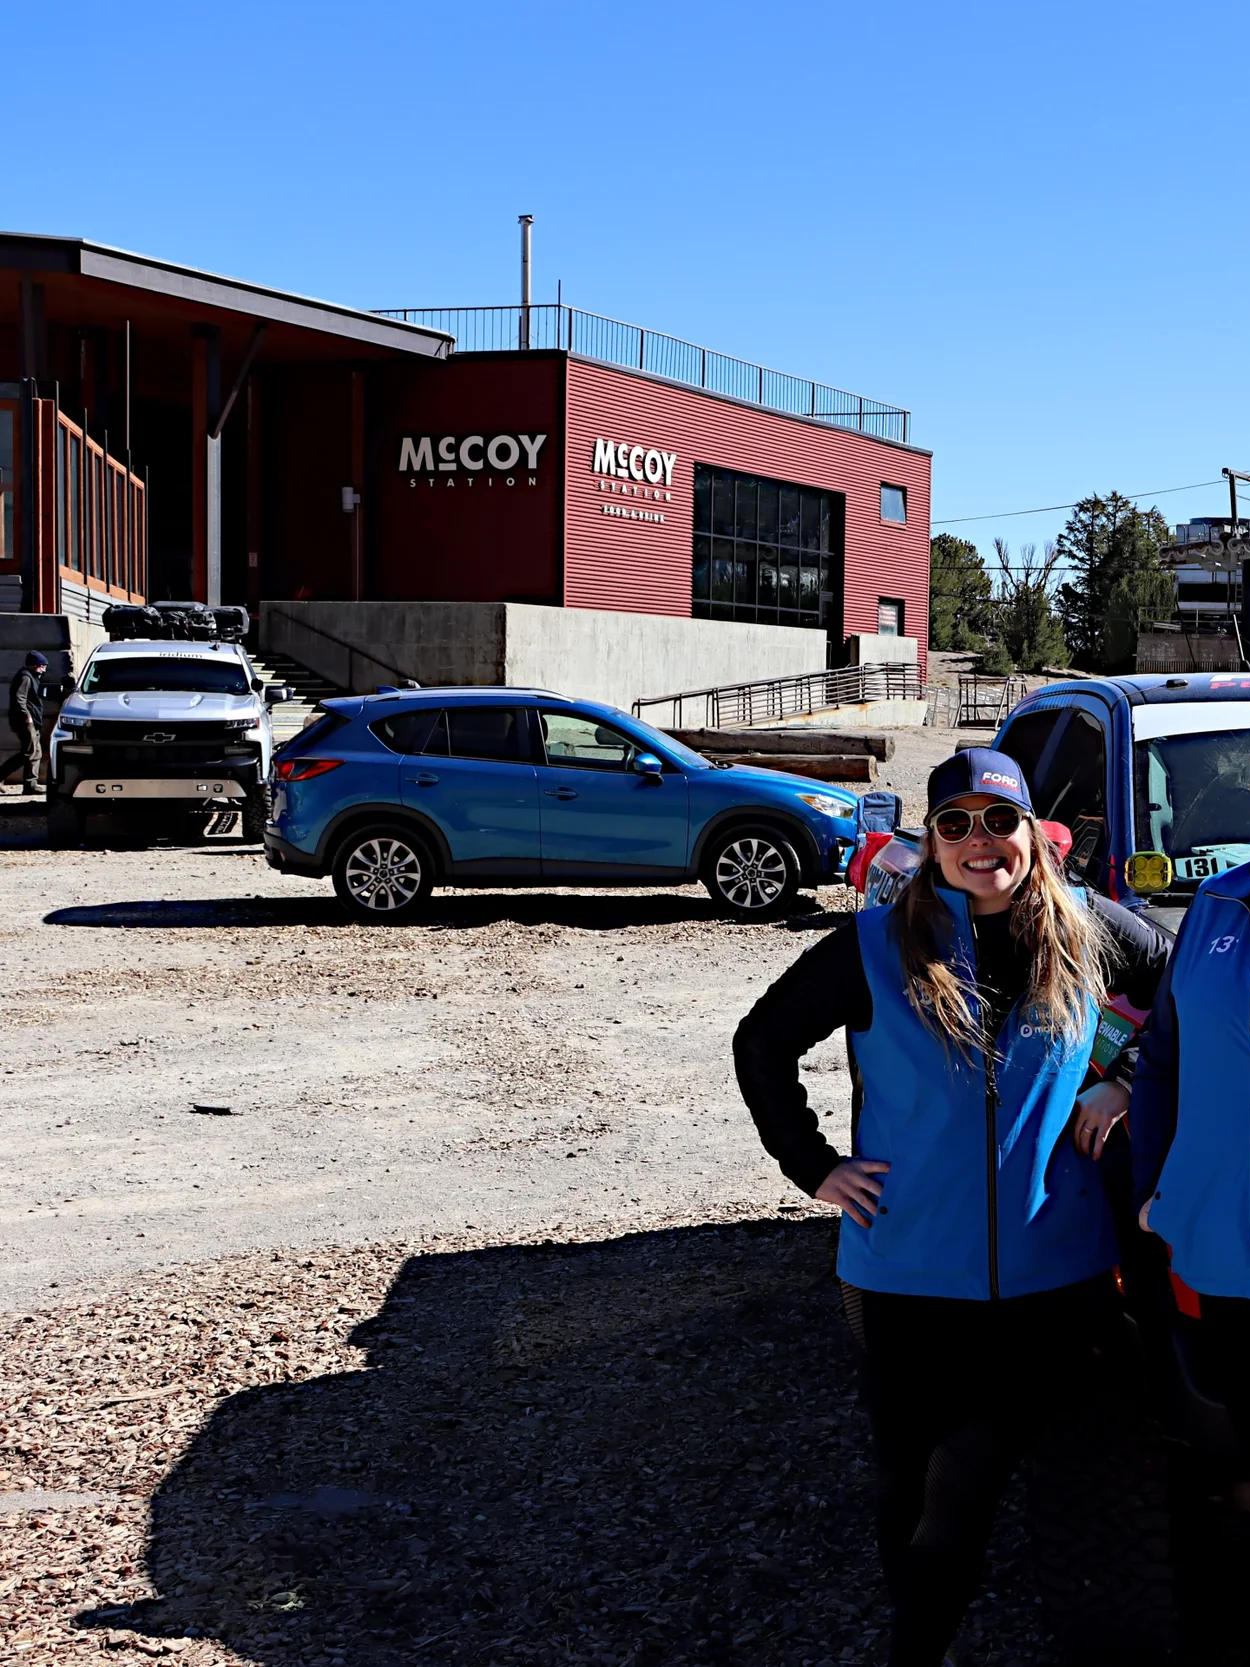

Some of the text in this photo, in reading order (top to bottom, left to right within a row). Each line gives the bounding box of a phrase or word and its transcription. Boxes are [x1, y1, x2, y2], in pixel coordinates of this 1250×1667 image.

[409, 477, 537, 488] STATION
[600, 480, 672, 501] STATION
[982, 771, 1019, 788] FORD
[1184, 856, 1219, 878] 131
